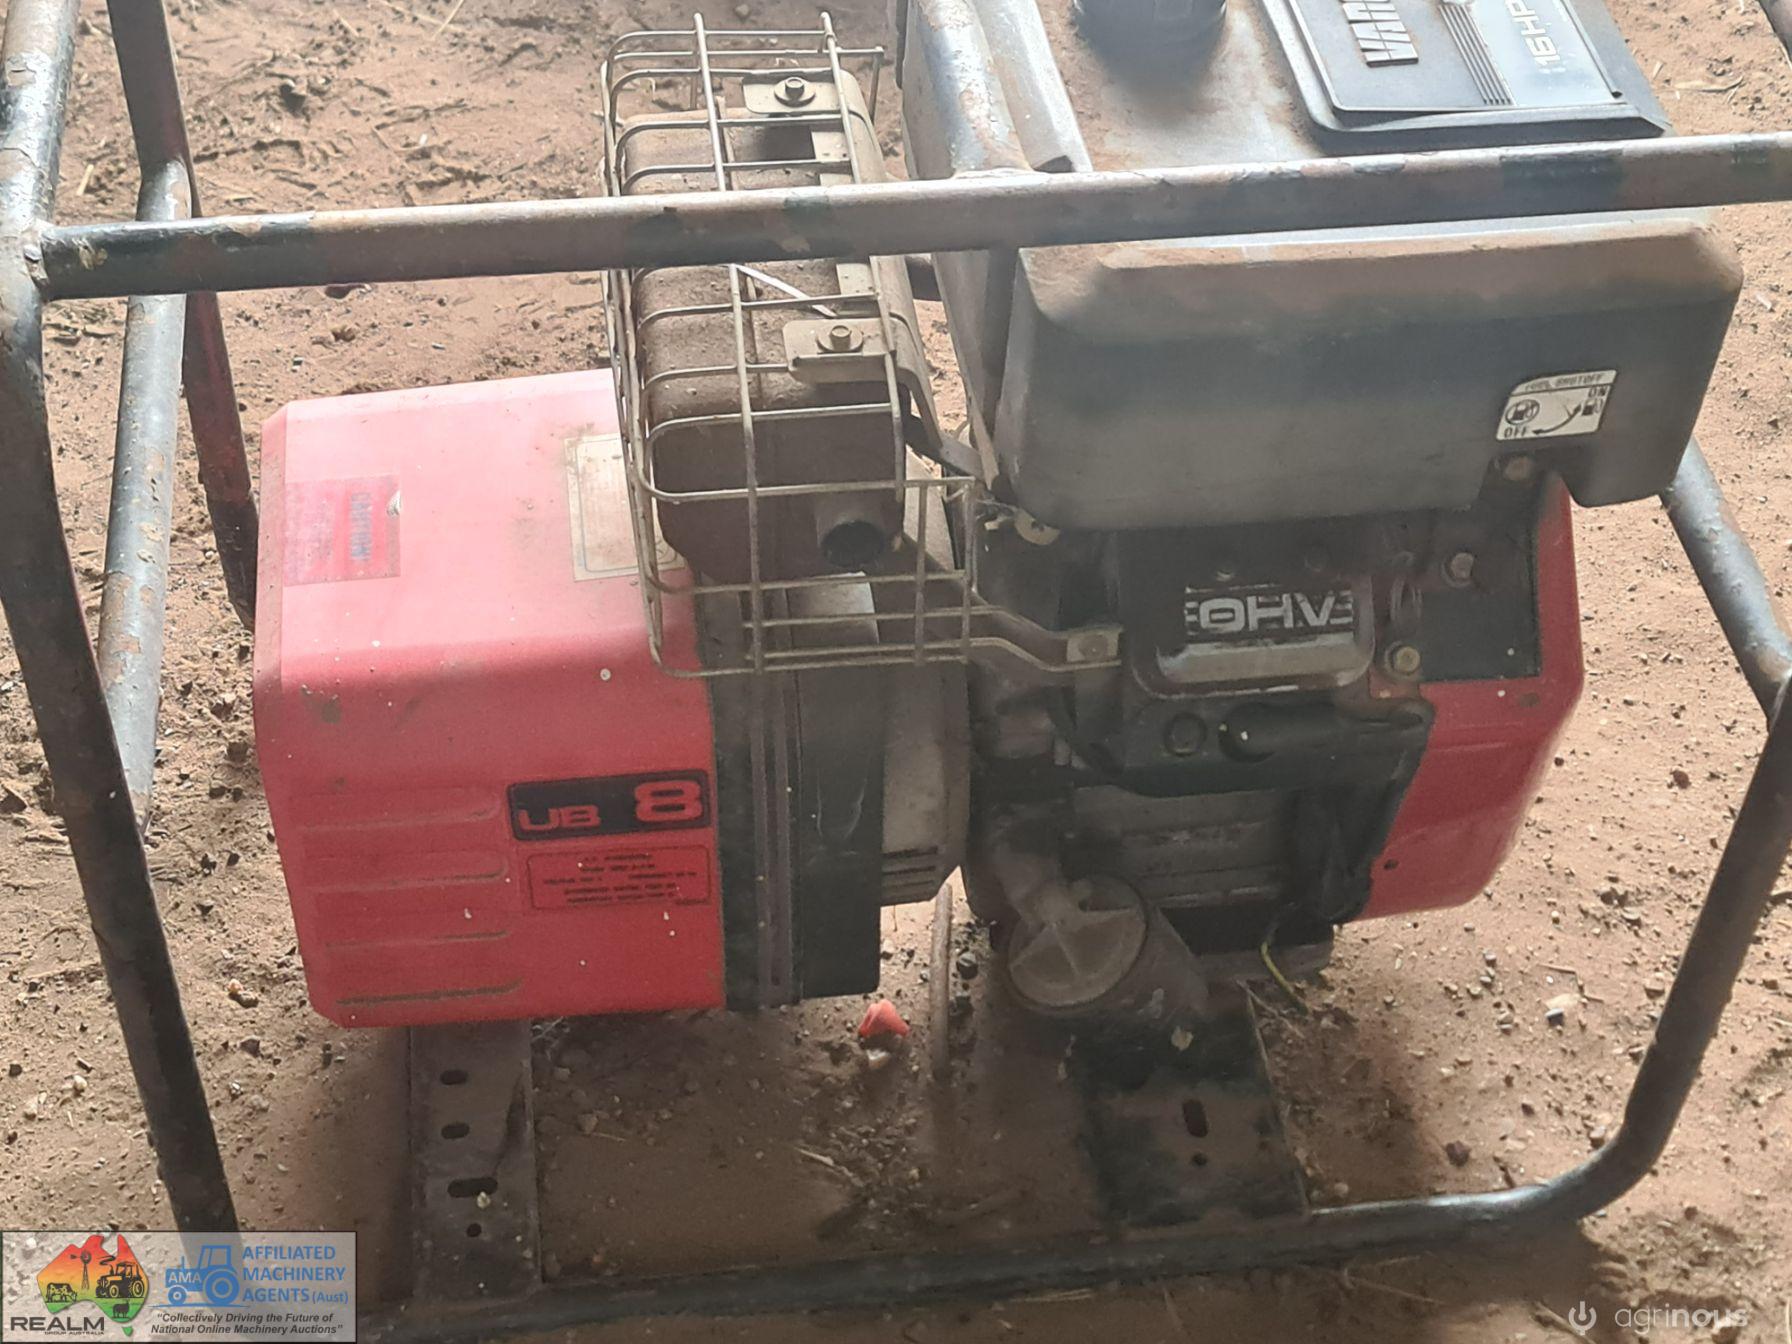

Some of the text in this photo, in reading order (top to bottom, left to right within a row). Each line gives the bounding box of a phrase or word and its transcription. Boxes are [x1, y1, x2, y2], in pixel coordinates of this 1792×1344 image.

[1588, 386, 1606, 397] ON
[1504, 426, 1527, 438] OFF
[1199, 592, 1337, 633] OHV
[518, 780, 703, 831] UB 8
